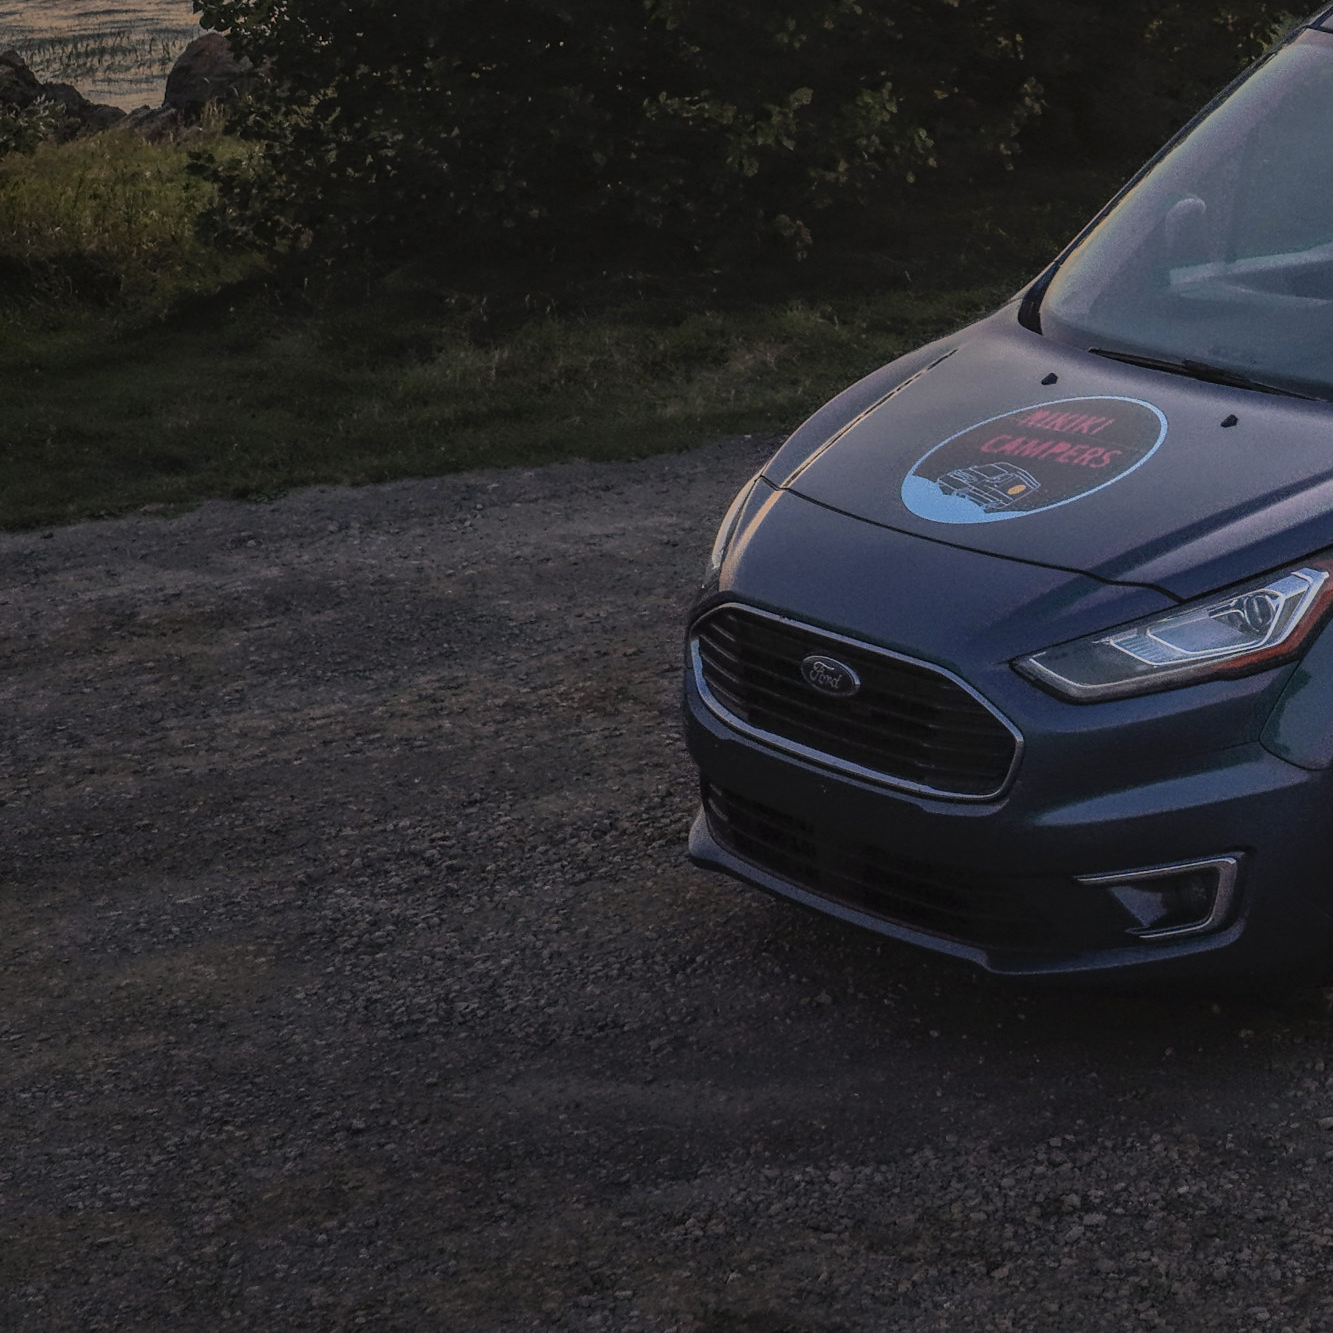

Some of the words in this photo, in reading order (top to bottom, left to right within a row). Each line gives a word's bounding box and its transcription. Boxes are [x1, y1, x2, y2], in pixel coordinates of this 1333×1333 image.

[1018, 410, 1116, 435] RIKIKI
[980, 434, 1123, 468] CAMPERS
[810, 661, 842, 689] Ford
